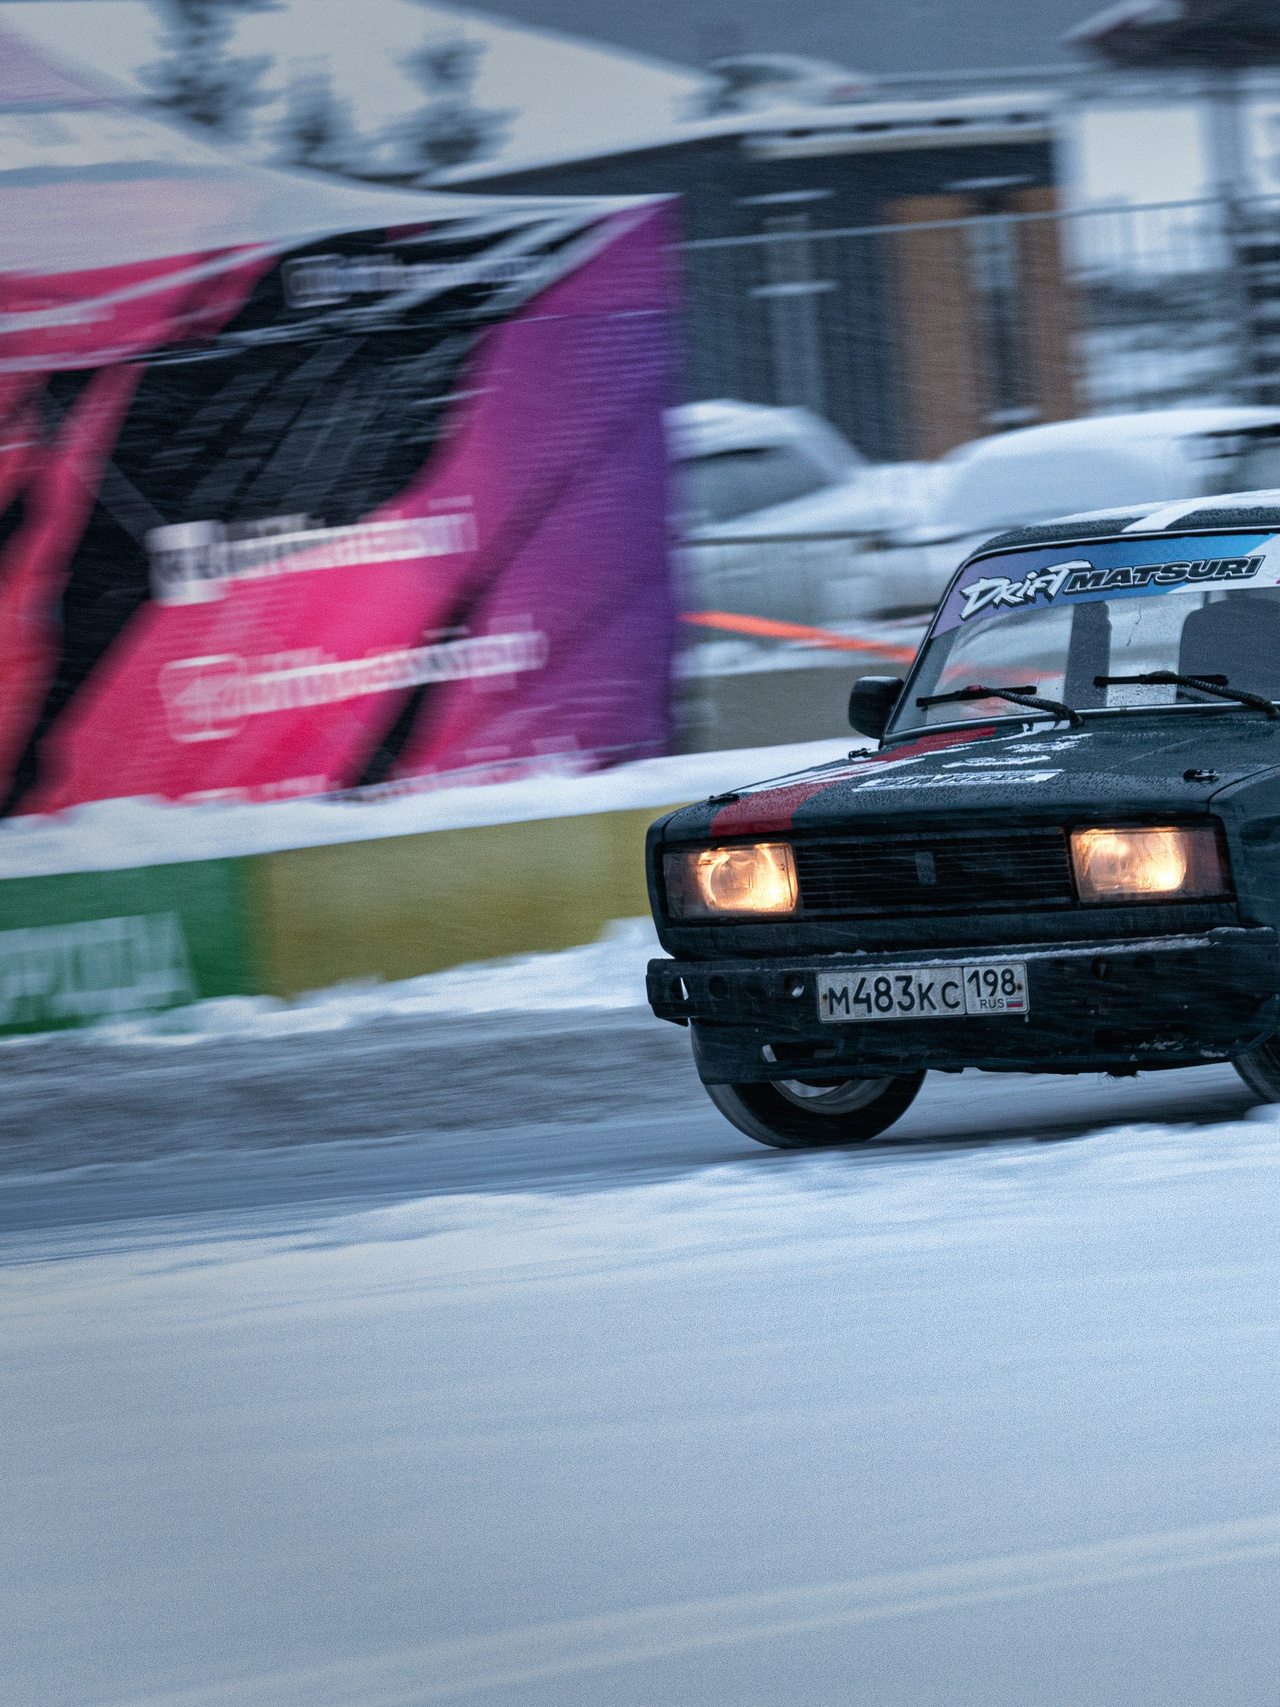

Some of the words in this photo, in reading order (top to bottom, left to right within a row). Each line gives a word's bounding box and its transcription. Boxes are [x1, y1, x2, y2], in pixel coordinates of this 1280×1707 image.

[1064, 555, 1266, 594] MATSURI
[828, 975, 960, 1015] М483КС
[967, 968, 1016, 998] 198
[980, 998, 1004, 1009] RUS
